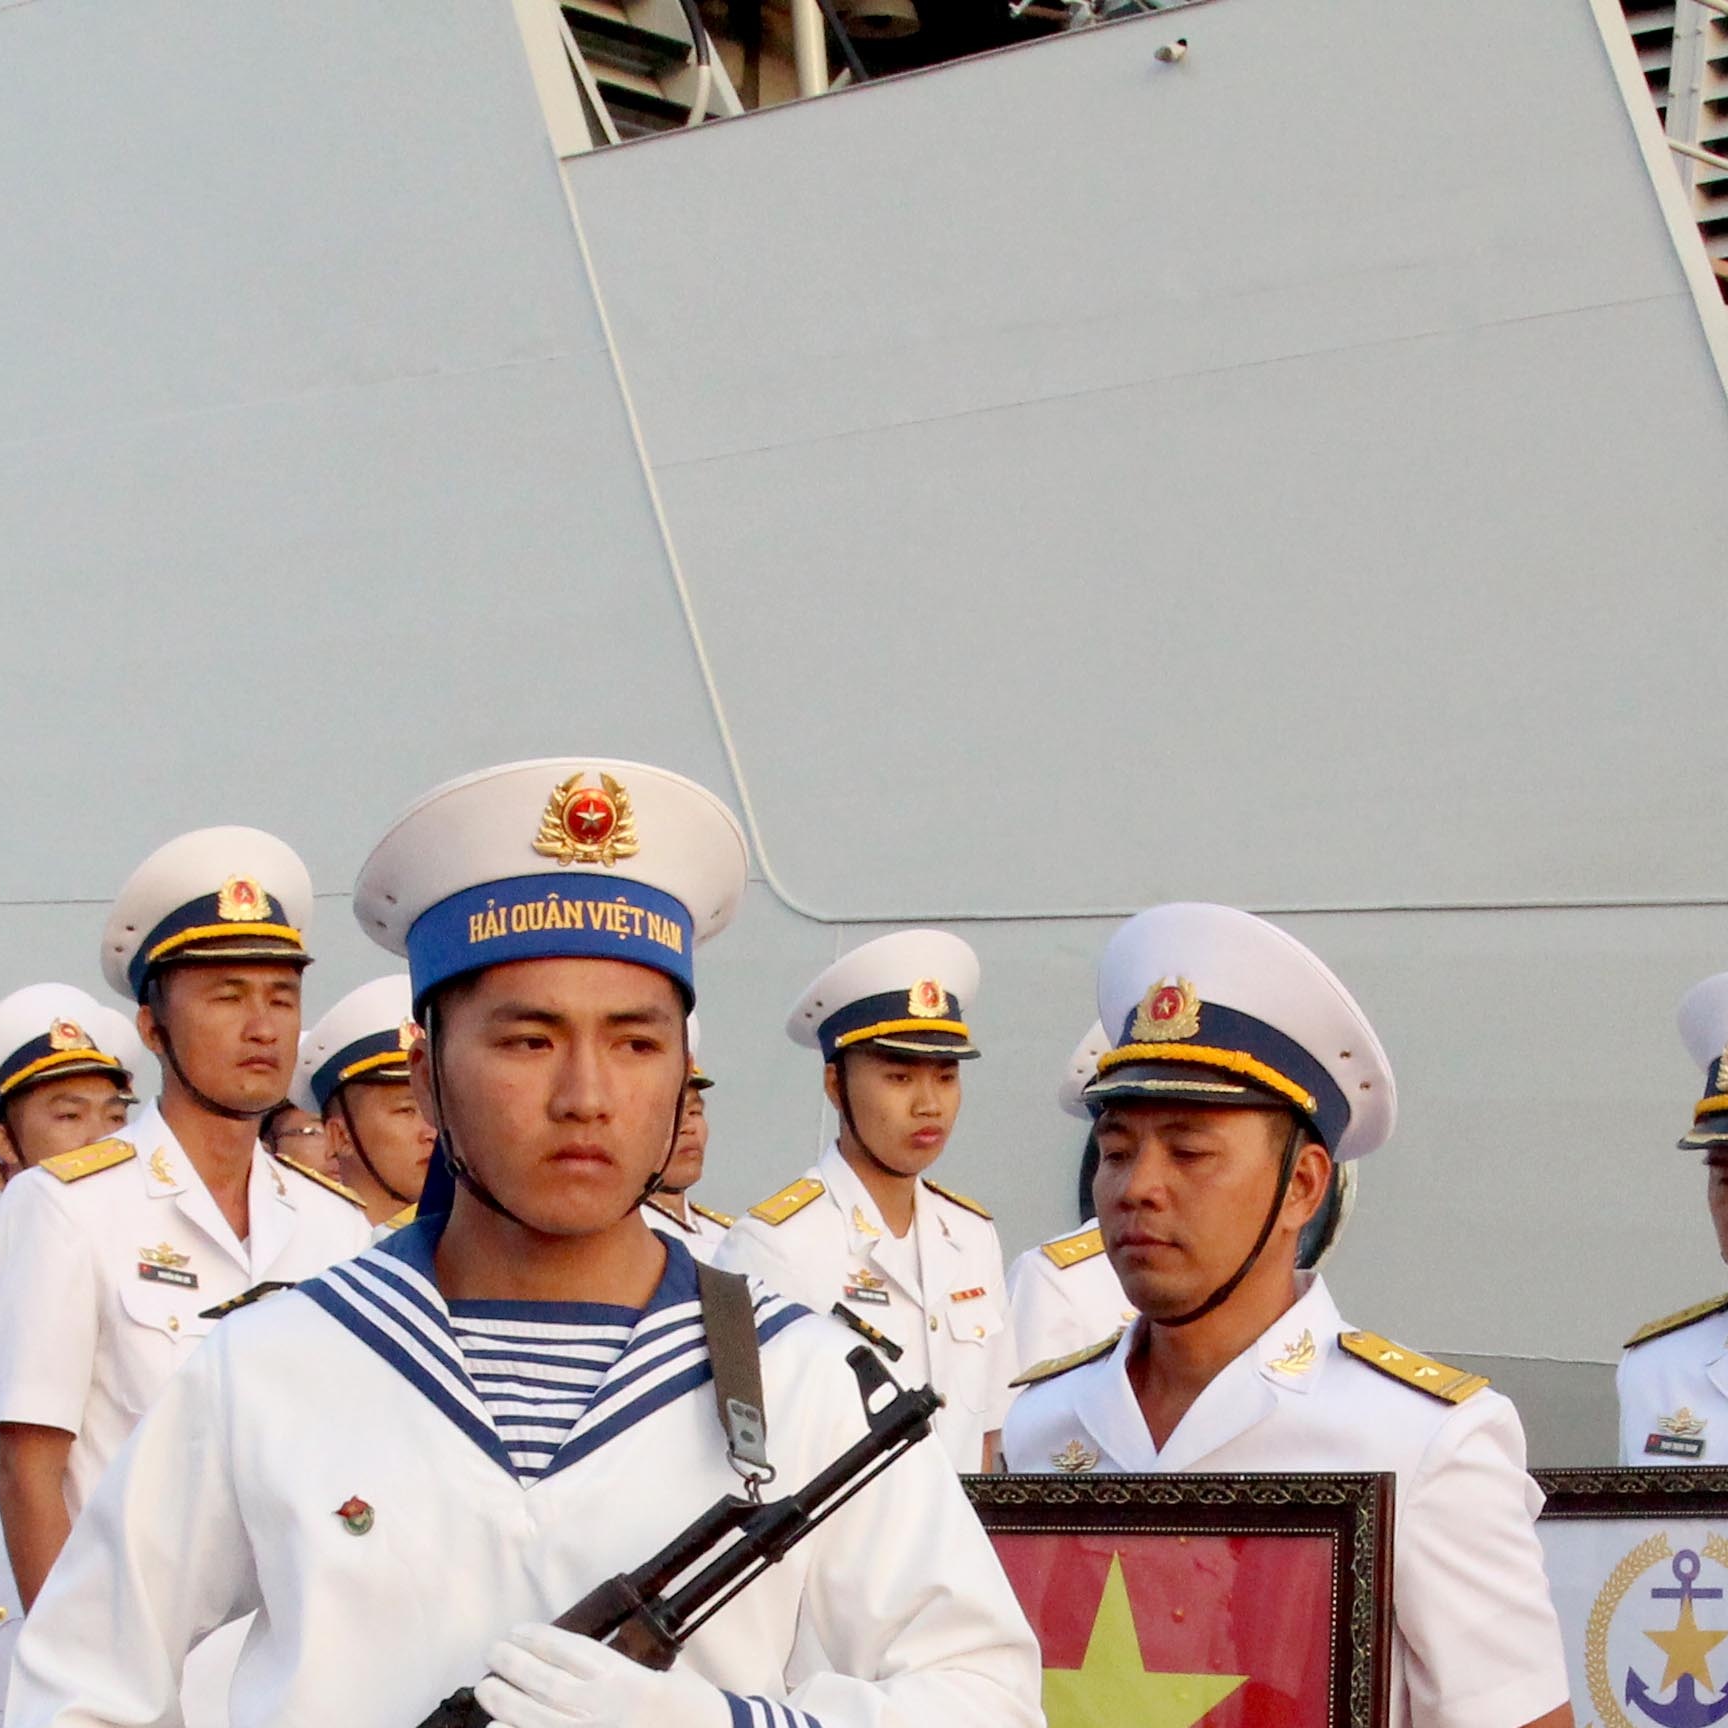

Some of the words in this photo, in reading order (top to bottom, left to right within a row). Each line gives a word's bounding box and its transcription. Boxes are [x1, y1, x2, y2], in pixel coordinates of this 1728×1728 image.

[469, 899, 509, 943] HẢI
[511, 892, 585, 933] QUÂN
[586, 896, 645, 940] VIỆT
[646, 912, 683, 954] NAM
